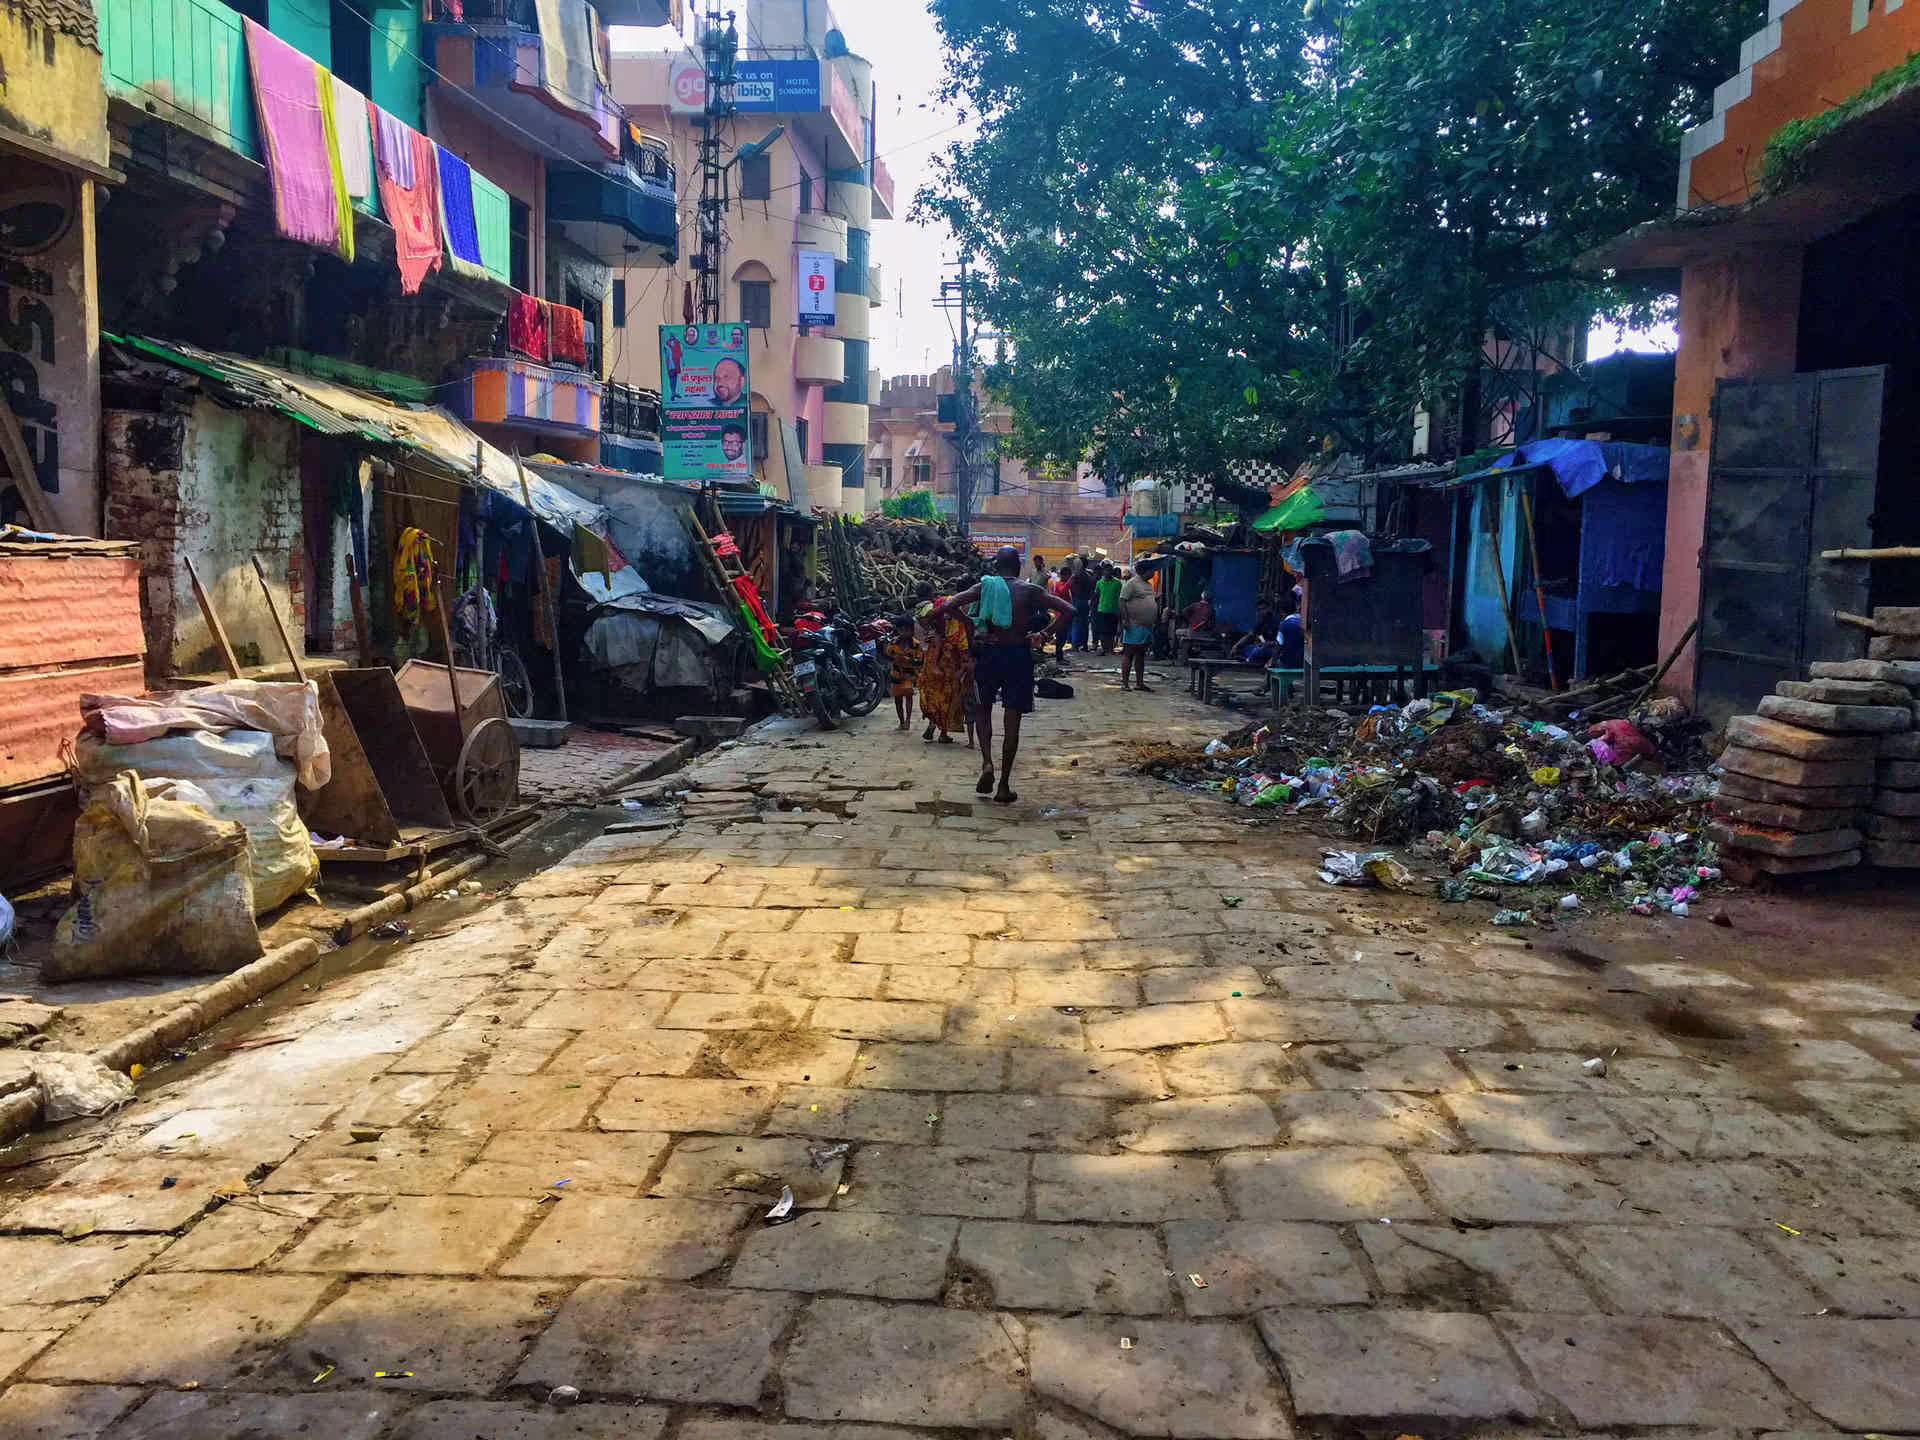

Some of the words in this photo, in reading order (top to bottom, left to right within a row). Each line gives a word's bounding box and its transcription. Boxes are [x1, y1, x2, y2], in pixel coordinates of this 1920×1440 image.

[745, 72, 757, 80] us
[760, 72, 773, 80] on
[784, 78, 809, 86] HOTEL
